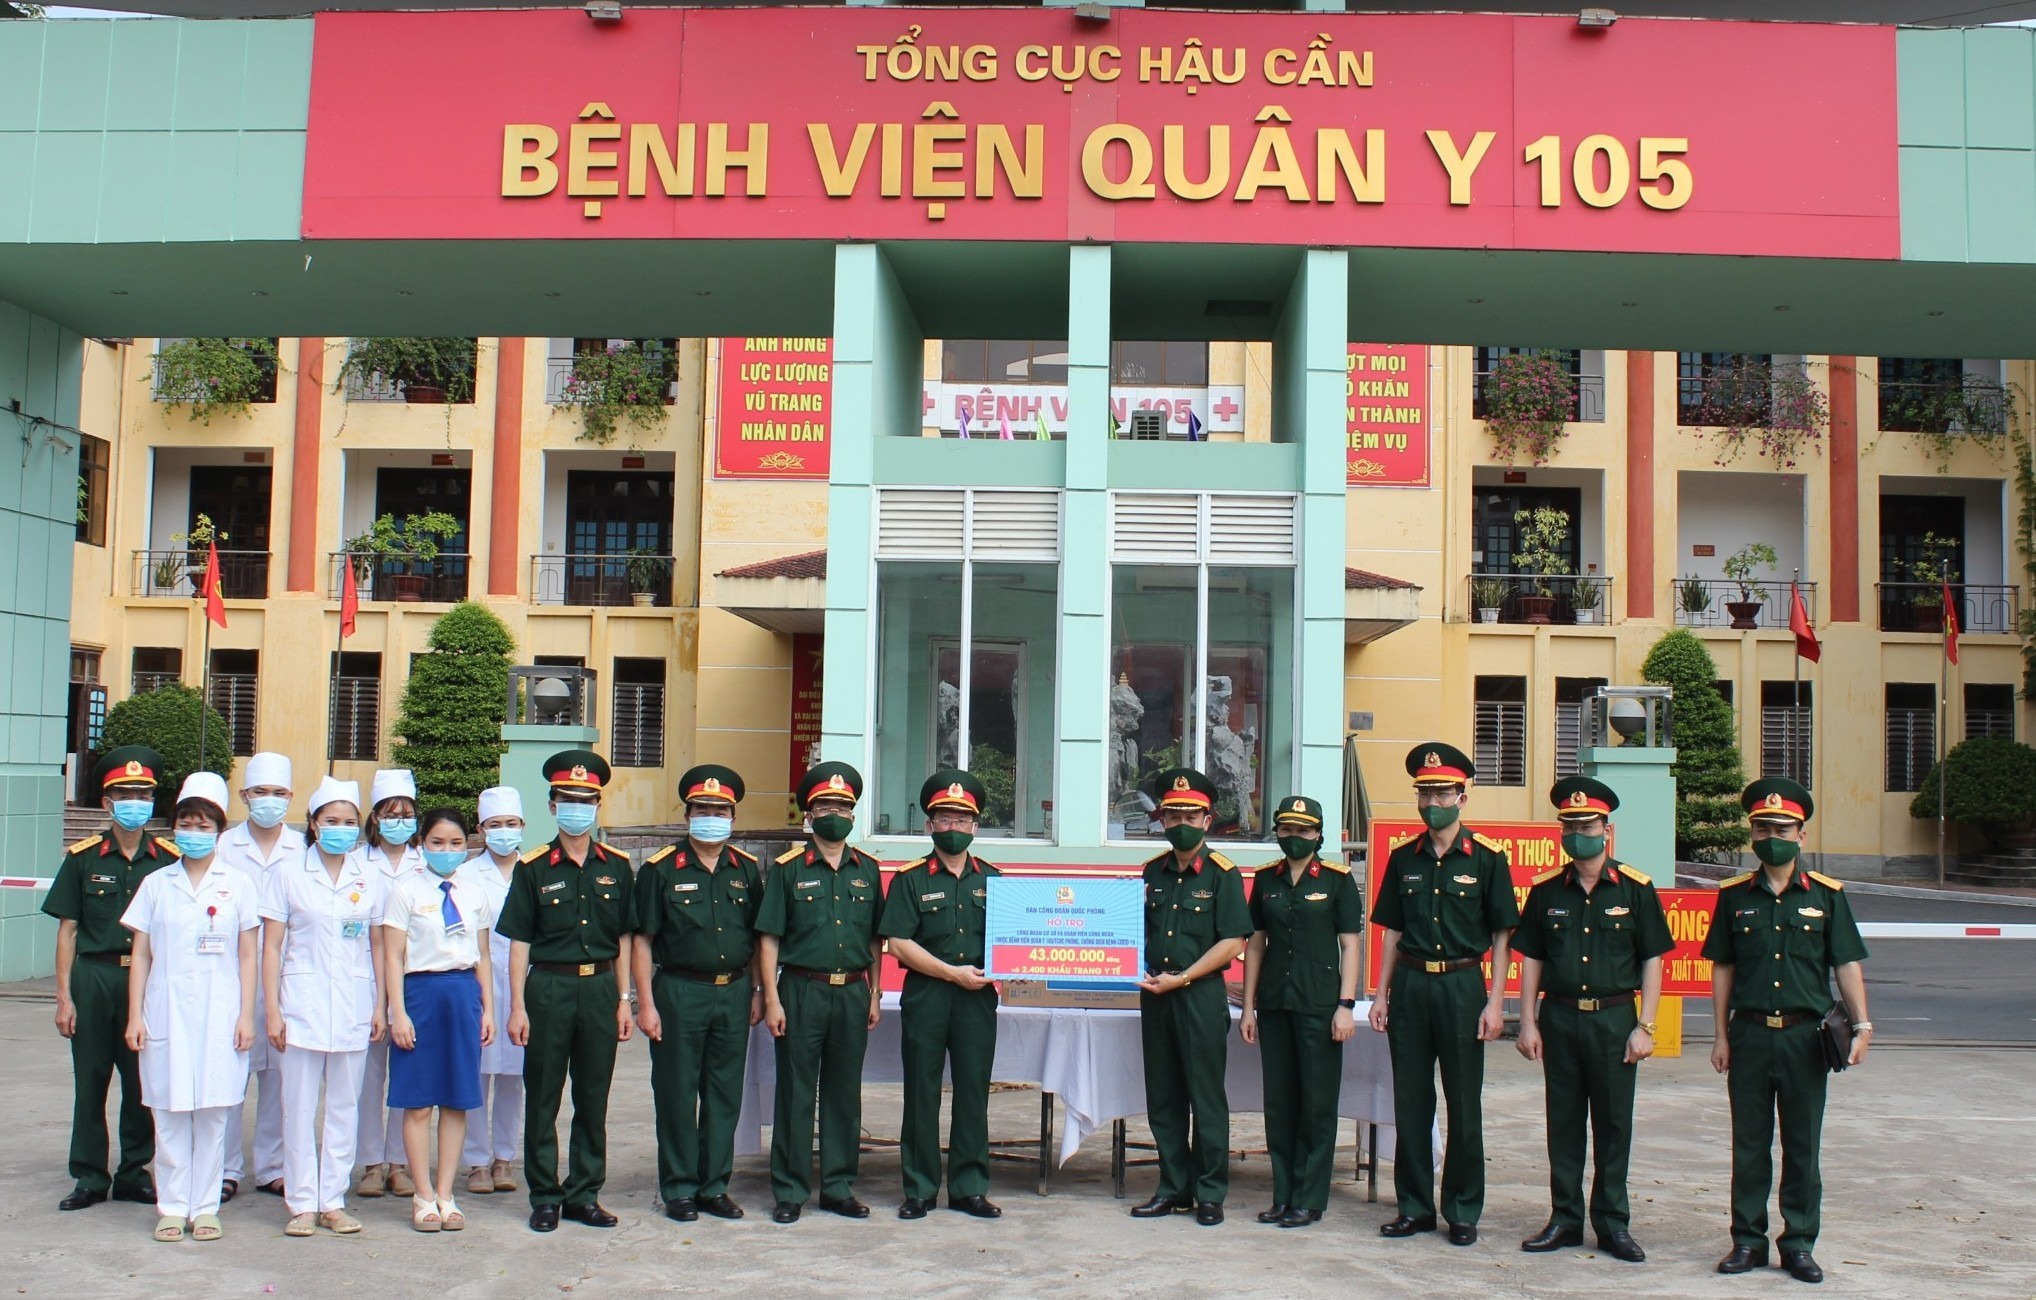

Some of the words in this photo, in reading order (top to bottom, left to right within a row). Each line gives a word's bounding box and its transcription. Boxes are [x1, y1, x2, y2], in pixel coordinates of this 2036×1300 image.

[856, 24, 997, 81] TỔNG
[1015, 45, 1121, 92] CỤC
[1139, 37, 1246, 94] HẬU
[1263, 33, 1374, 87] CẦN
[501, 102, 769, 218] BỆNH
[806, 101, 1044, 219] VIỆN
[1081, 105, 1386, 203] QUÂN
[1426, 130, 1497, 205] Y
[1524, 133, 1693, 210] 105
[745, 337, 777, 352] ANH
[740, 362, 771, 385] LỰC
[775, 362, 829, 386] LƯỢNG
[1371, 355, 1406, 375] MỌI
[1359, 378, 1409, 398] KHĂN
[745, 390, 766, 411] VŨ
[769, 394, 822, 412] TRANG
[955, 387, 1042, 428] BỆNH
[1050, 397, 1127, 422] VN
[1140, 398, 1192, 424] 105
[1360, 404, 1421, 424] THÀNH
[741, 420, 786, 441] NHÂN
[790, 420, 824, 442] DÂN
[1384, 433, 1408, 453] VỤ
[1517, 837, 1555, 872] THỰC
[1029, 948, 1105, 962] 43.000.000
[1022, 966, 1045, 974] 2.400
[1073, 967, 1102, 976] TRANG
[1104, 967, 1110, 975] Y
[1671, 953, 1692, 982] XUẤT
[1693, 957, 1714, 982] TRÌN
